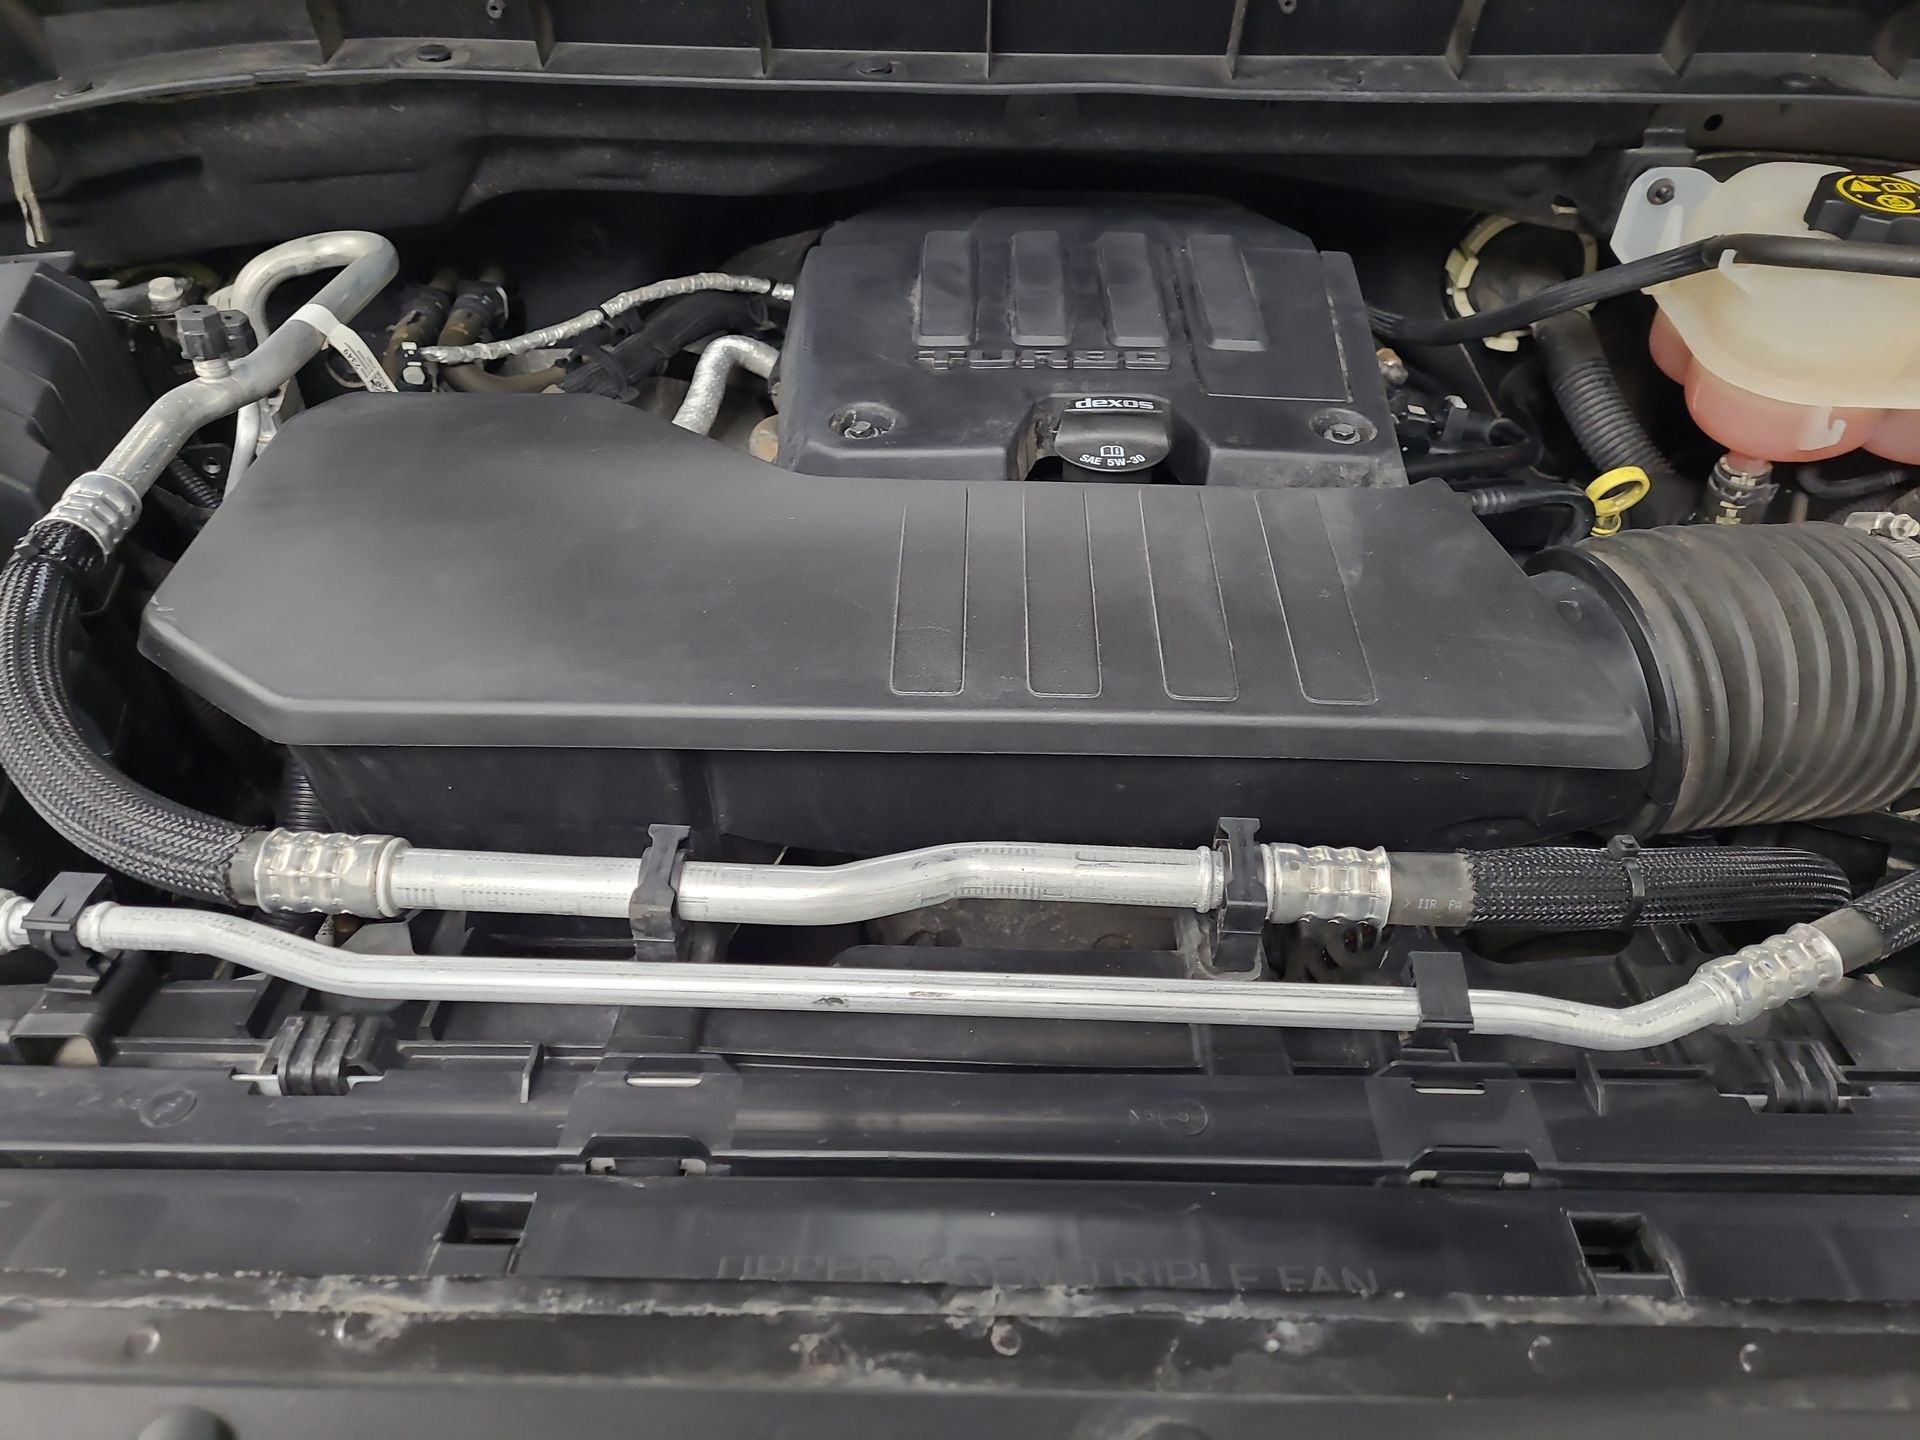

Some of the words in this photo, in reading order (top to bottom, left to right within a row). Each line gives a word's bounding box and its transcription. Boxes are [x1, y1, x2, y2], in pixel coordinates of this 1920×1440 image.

[914, 350, 1172, 370] TURBO
[1075, 397, 1155, 410] dexos
[1079, 454, 1103, 466] SAE
[1106, 454, 1146, 467] 5W-30
[717, 1255, 897, 1282] UPPER
[1081, 1258, 1260, 1291] TRIPLE
[1277, 1264, 1379, 1294] FAN
